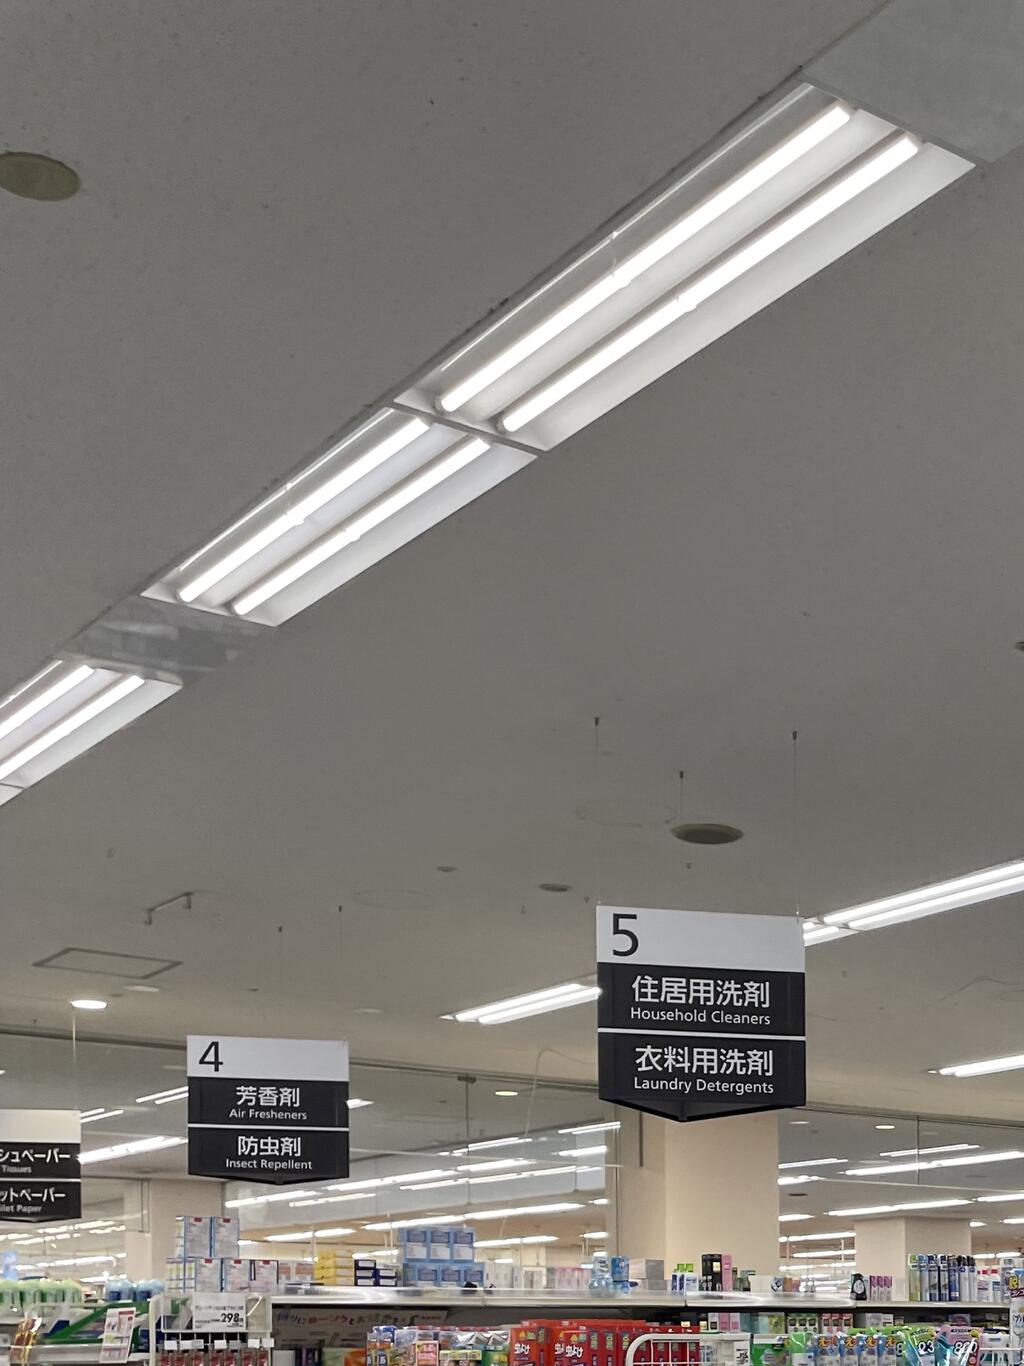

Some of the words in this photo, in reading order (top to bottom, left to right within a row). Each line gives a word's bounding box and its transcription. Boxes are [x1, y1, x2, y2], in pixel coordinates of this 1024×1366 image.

[613, 913, 639, 956] 5
[632, 976, 770, 1008] 住居用洗剤
[631, 1008, 706, 1022] Household
[711, 1011, 770, 1025] Cleaners
[199, 1041, 223, 1072] 4
[635, 1046, 773, 1076] 衣料用洗剤
[634, 1077, 691, 1093] Laundry
[696, 1079, 774, 1095] Detergents
[236, 1086, 300, 1107] 芳香剤
[229, 1109, 246, 1118] Air
[249, 1109, 307, 1120] Fresheners
[238, 1136, 301, 1156] 防虫剤
[3, 1165, 32, 1173] Tissues
[226, 1159, 257, 1168] Insect
[261, 1160, 312, 1170] Repellent
[17, 1204, 42, 1213] Paper
